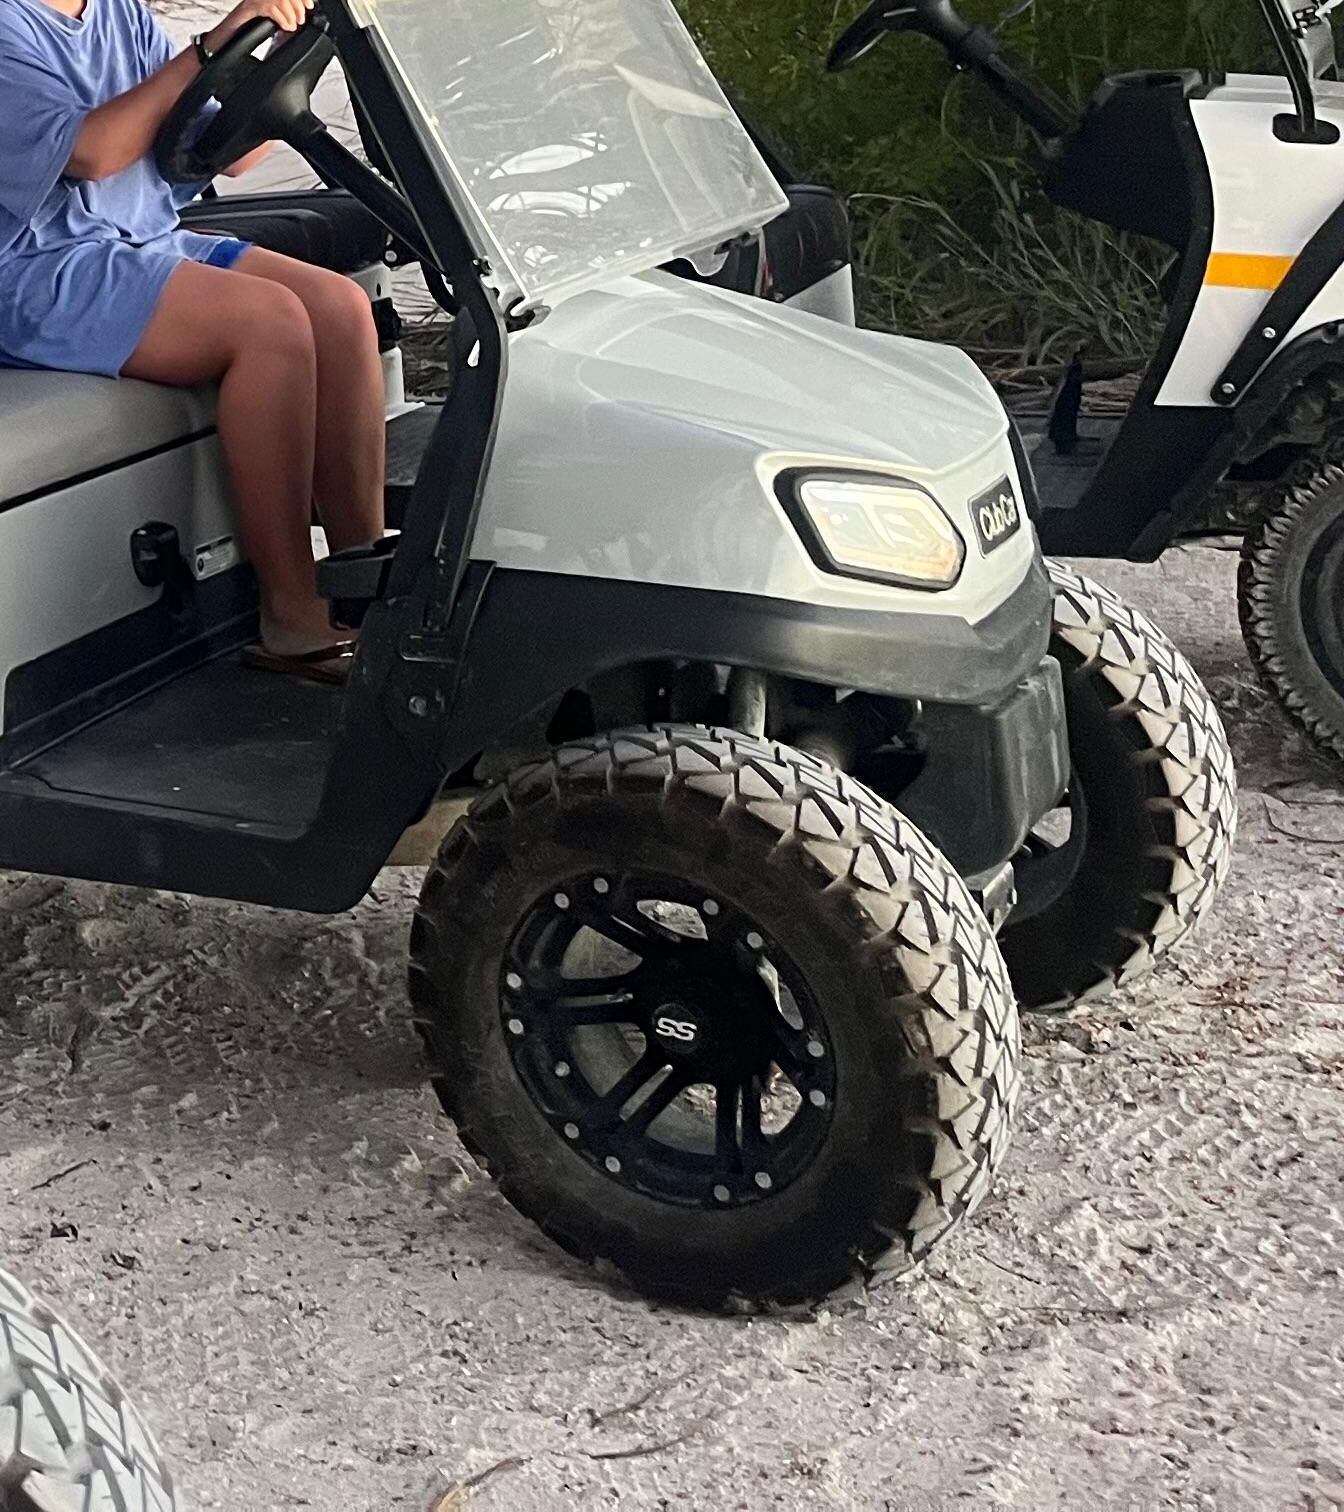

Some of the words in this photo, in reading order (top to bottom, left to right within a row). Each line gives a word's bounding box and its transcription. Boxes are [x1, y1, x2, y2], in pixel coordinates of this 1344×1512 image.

[979, 502, 1005, 541] Club
[999, 494, 1017, 526] Ca
[656, 1017, 697, 1040] SS
